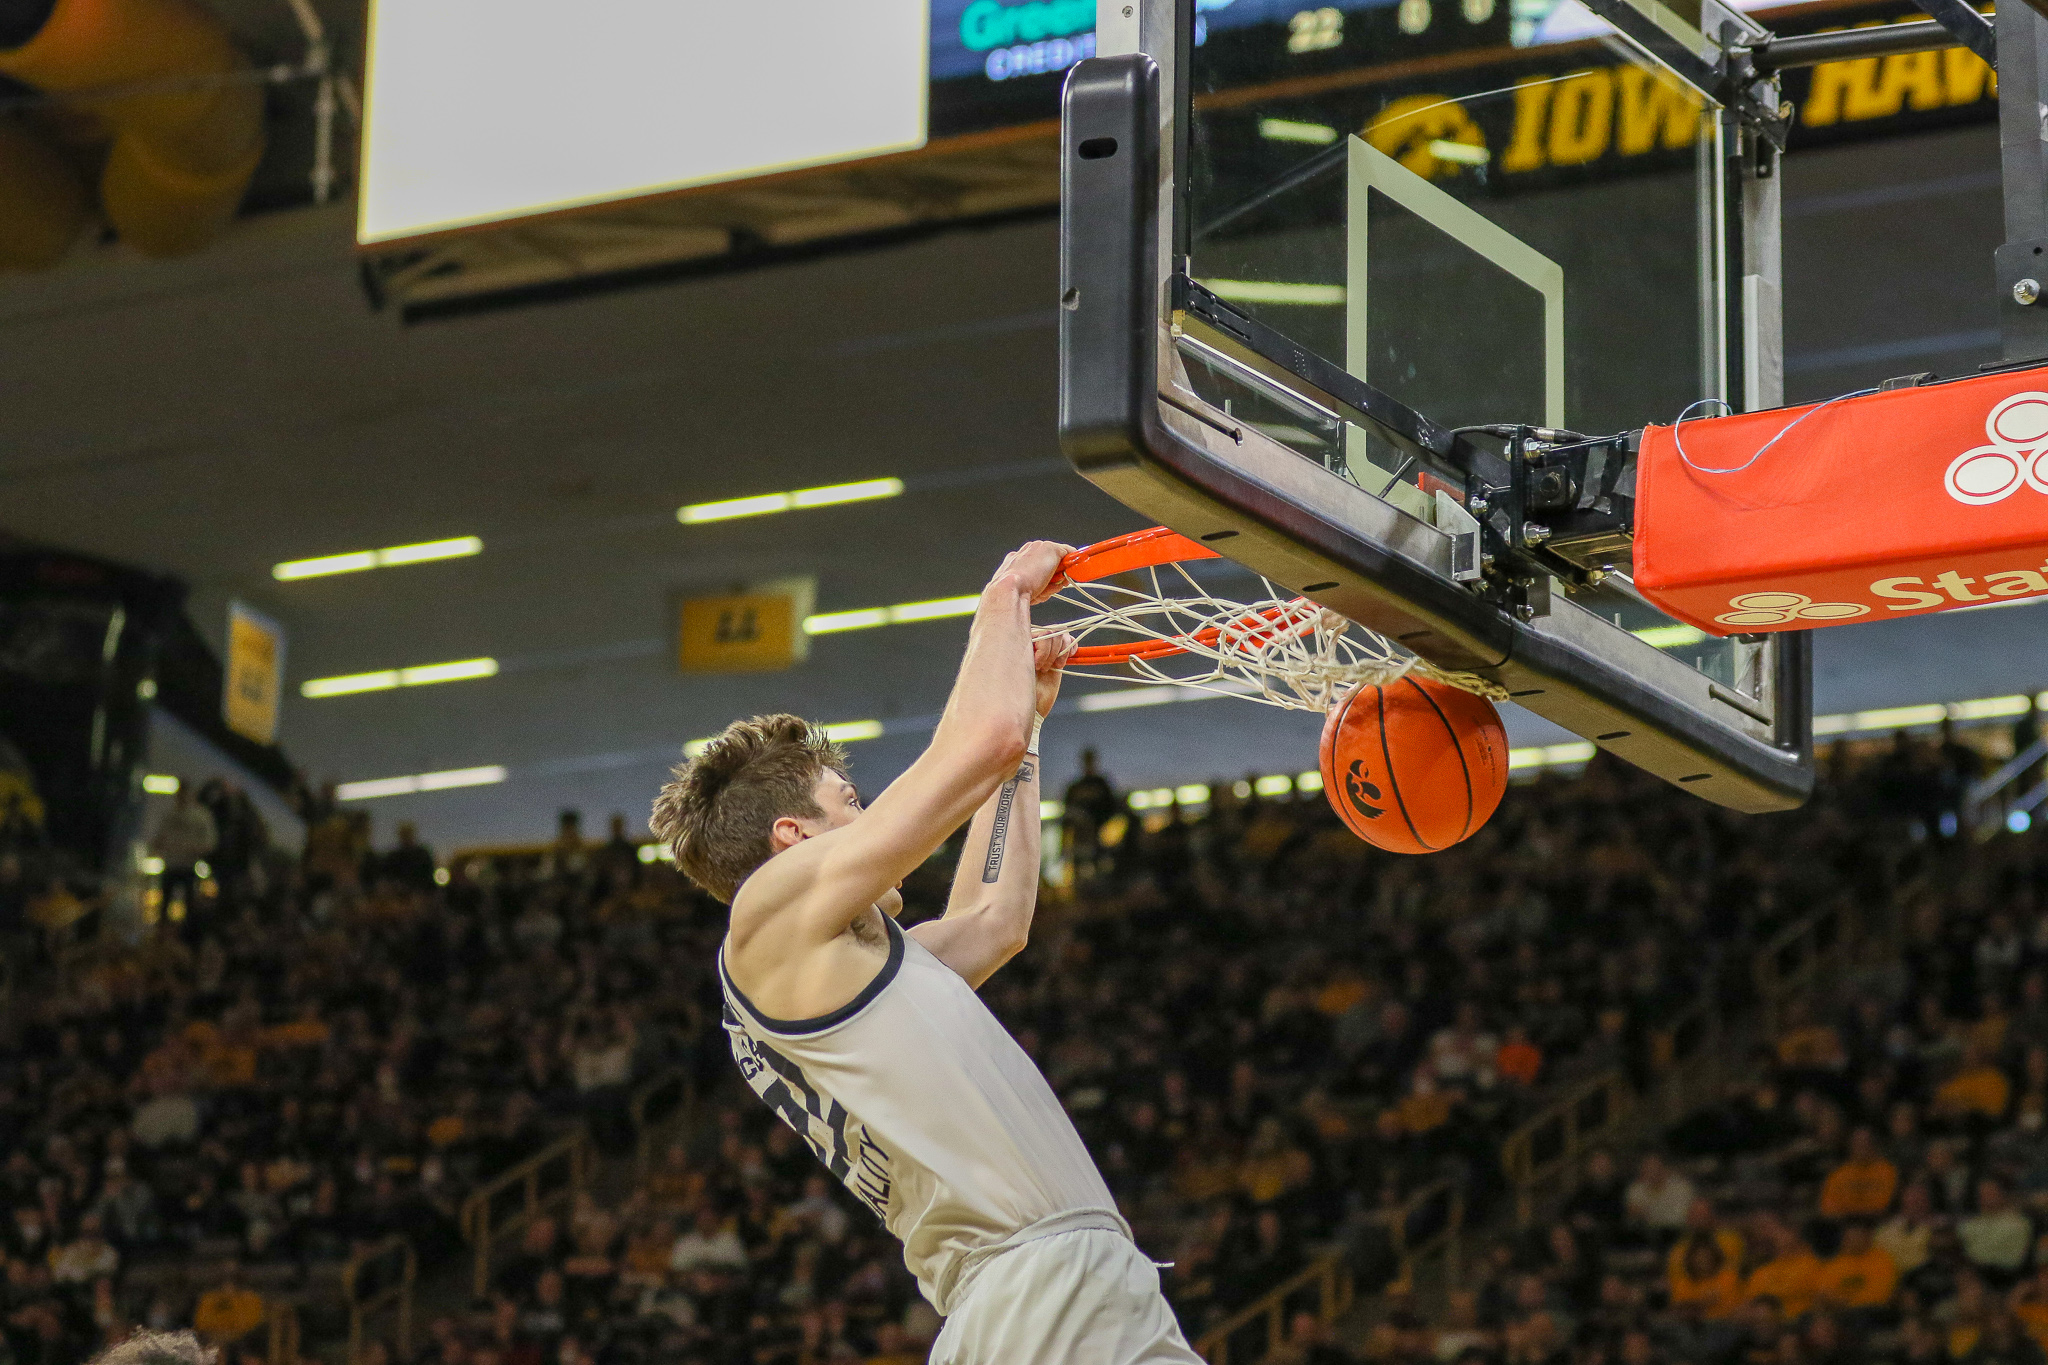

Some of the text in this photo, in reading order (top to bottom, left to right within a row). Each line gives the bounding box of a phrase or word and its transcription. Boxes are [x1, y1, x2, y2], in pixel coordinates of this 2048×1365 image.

[1503, 65, 1715, 172] IOW
[1869, 558, 2048, 611] Sta
[988, 786, 1014, 872] TRUST YOUR WORK
[857, 1124, 892, 1217] ALITY
